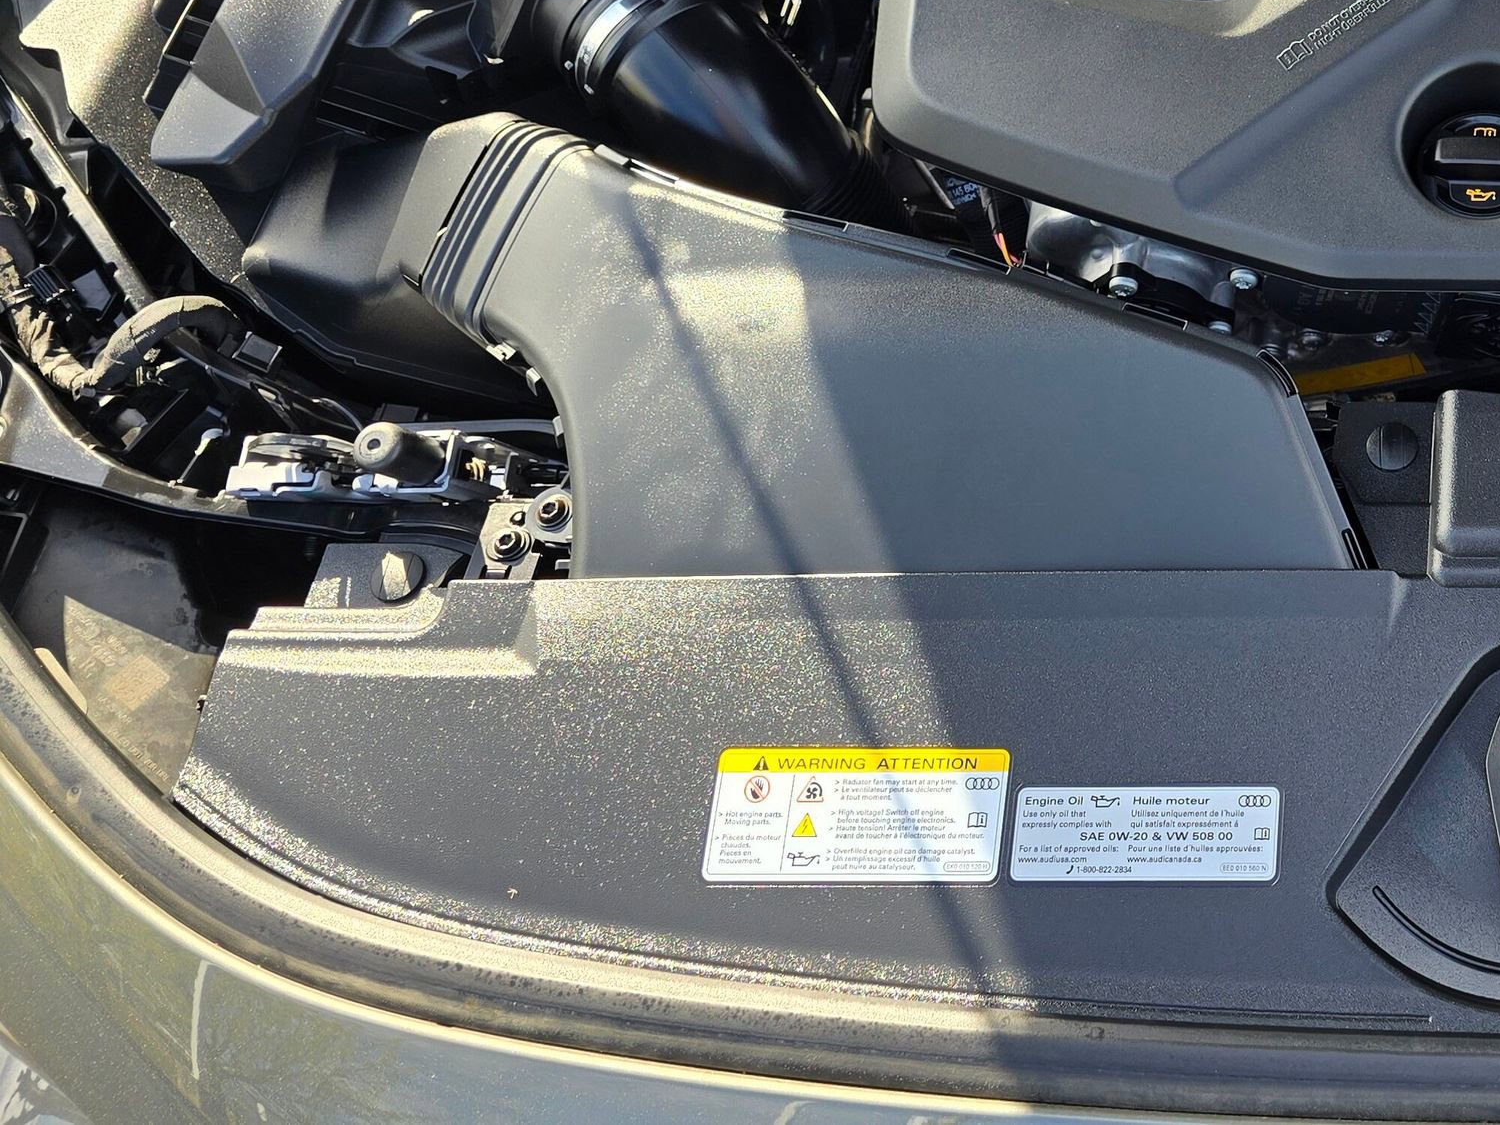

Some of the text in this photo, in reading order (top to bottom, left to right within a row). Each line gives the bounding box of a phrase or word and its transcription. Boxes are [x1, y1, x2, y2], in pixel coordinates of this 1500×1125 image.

[1307, 28, 1322, 42] DO
[1321, 15, 1340, 32] NOT
[1314, 26, 1342, 50] NICHT
[778, 757, 978, 770] WARNING ATTENTION
[886, 779, 900, 787] may
[926, 779, 939, 787] any
[1025, 796, 1084, 807] Engine Oil
[1132, 796, 1210, 805] Huile moteur
[740, 811, 762, 819] engine
[920, 809, 944, 817] engine
[1040, 810, 1057, 819] only
[1130, 809, 1159, 817] Utilisez
[1160, 809, 1208, 819] uniquement
[1208, 809, 1220, 817] de
[860, 817, 890, 826] touching
[892, 818, 916, 826] engine
[1022, 820, 1112, 829] expressly complies with
[1130, 820, 1143, 829] qui
[1080, 831, 1233, 841] SAE 0W-20 & VW 508 00
[868, 849, 892, 857] engine
[1018, 845, 1032, 853] For
[1040, 845, 1052, 853] list
[1054, 845, 1063, 853] of
[1064, 845, 1100, 855] approved
[1128, 845, 1146, 853] Pour
[1164, 845, 1181, 853] liste
[1018, 855, 1088, 863] www.audiusa.com
[1126, 855, 1203, 863] www.audicanada.ca
[1076, 865, 1132, 873] 1-800-822-2834
